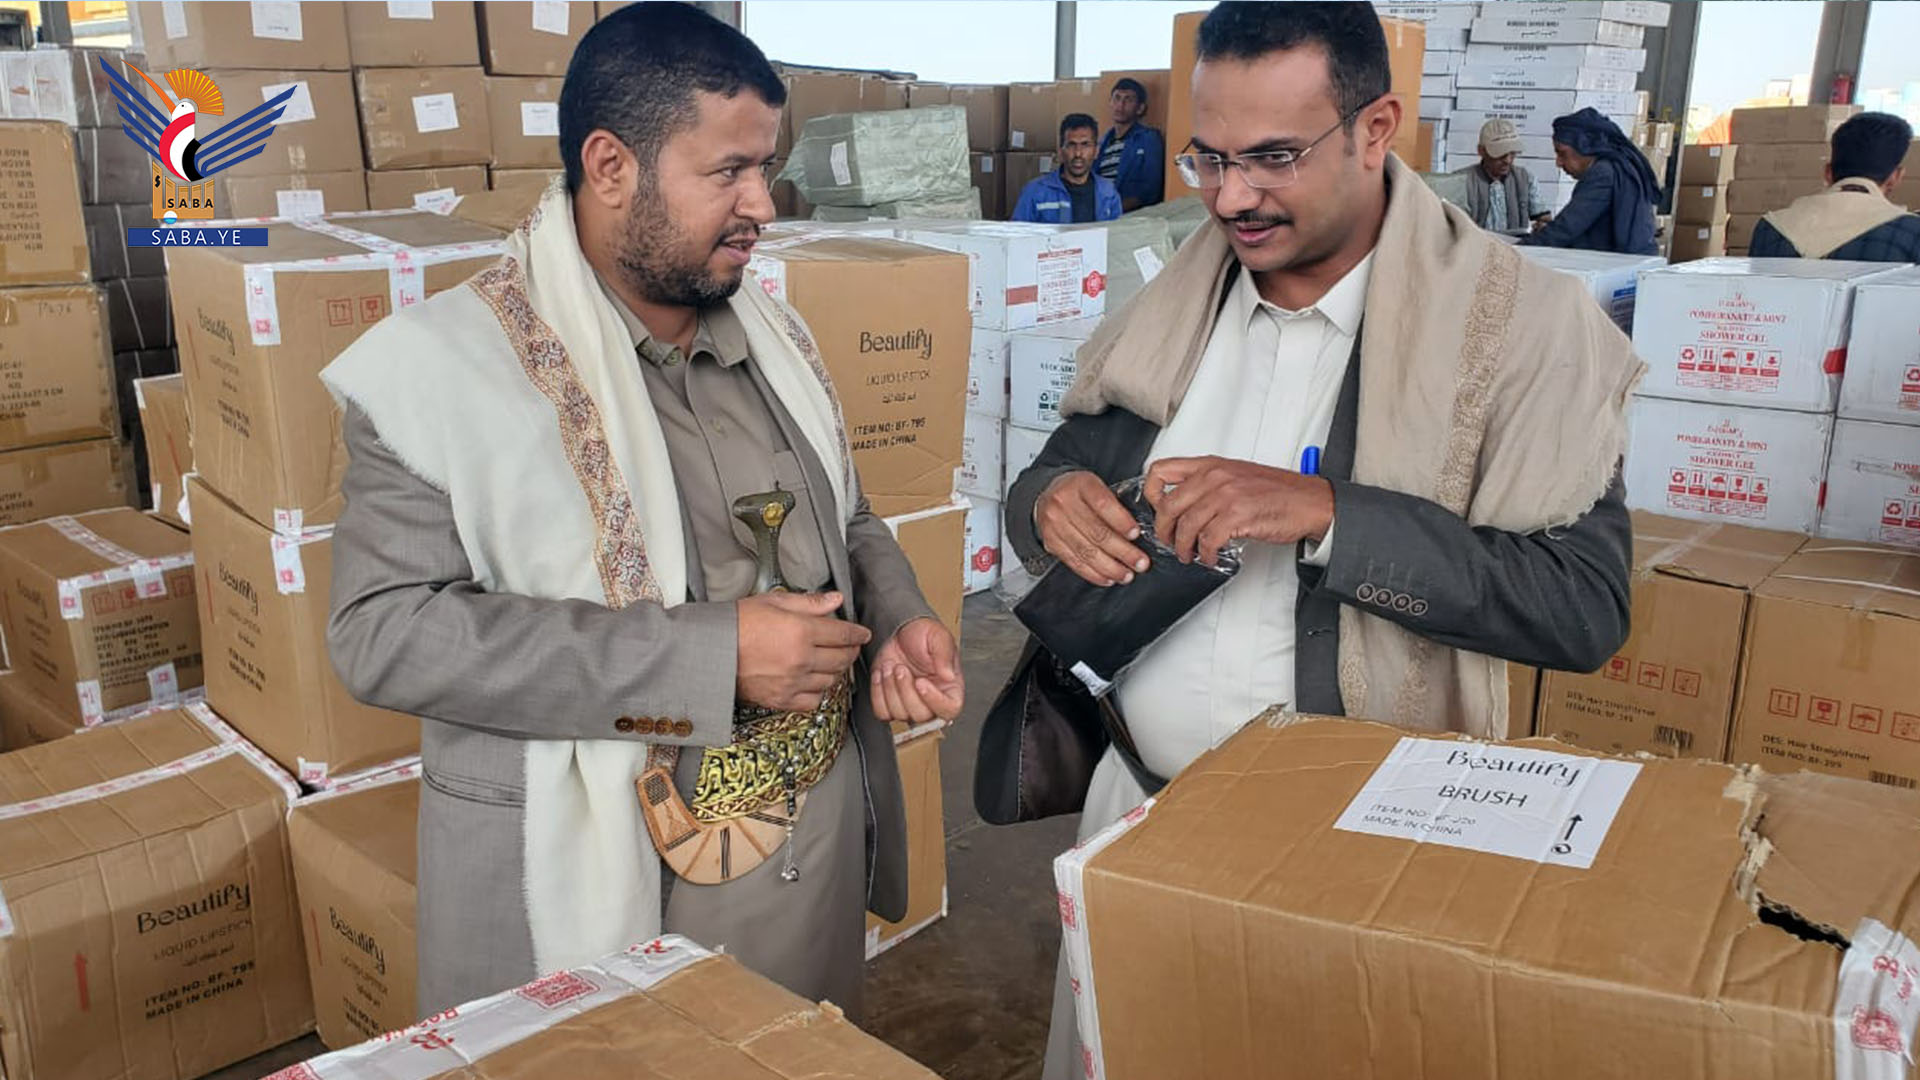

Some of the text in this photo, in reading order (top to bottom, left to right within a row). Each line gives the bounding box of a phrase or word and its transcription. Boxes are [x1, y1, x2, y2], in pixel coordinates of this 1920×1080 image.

[860, 328, 933, 360] Beautify
[1700, 330, 1767, 343] SHOWER GEL
[854, 423, 877, 436] ITEM
[852, 434, 917, 451] MADE IN CHINA
[1690, 455, 1734, 467] SHOWER
[1761, 746, 1786, 758] ITEM
[1446, 749, 1581, 788] Beautify
[1438, 785, 1528, 809] BRUSH
[1370, 803, 1403, 814] ITEM
[1362, 815, 1463, 836] MADE IN CHINA
[136, 883, 251, 935] Beautify
[329, 905, 386, 976] Beautify
[145, 987, 179, 1009] ITEM
[145, 977, 244, 1020] MADE IN CHINA
